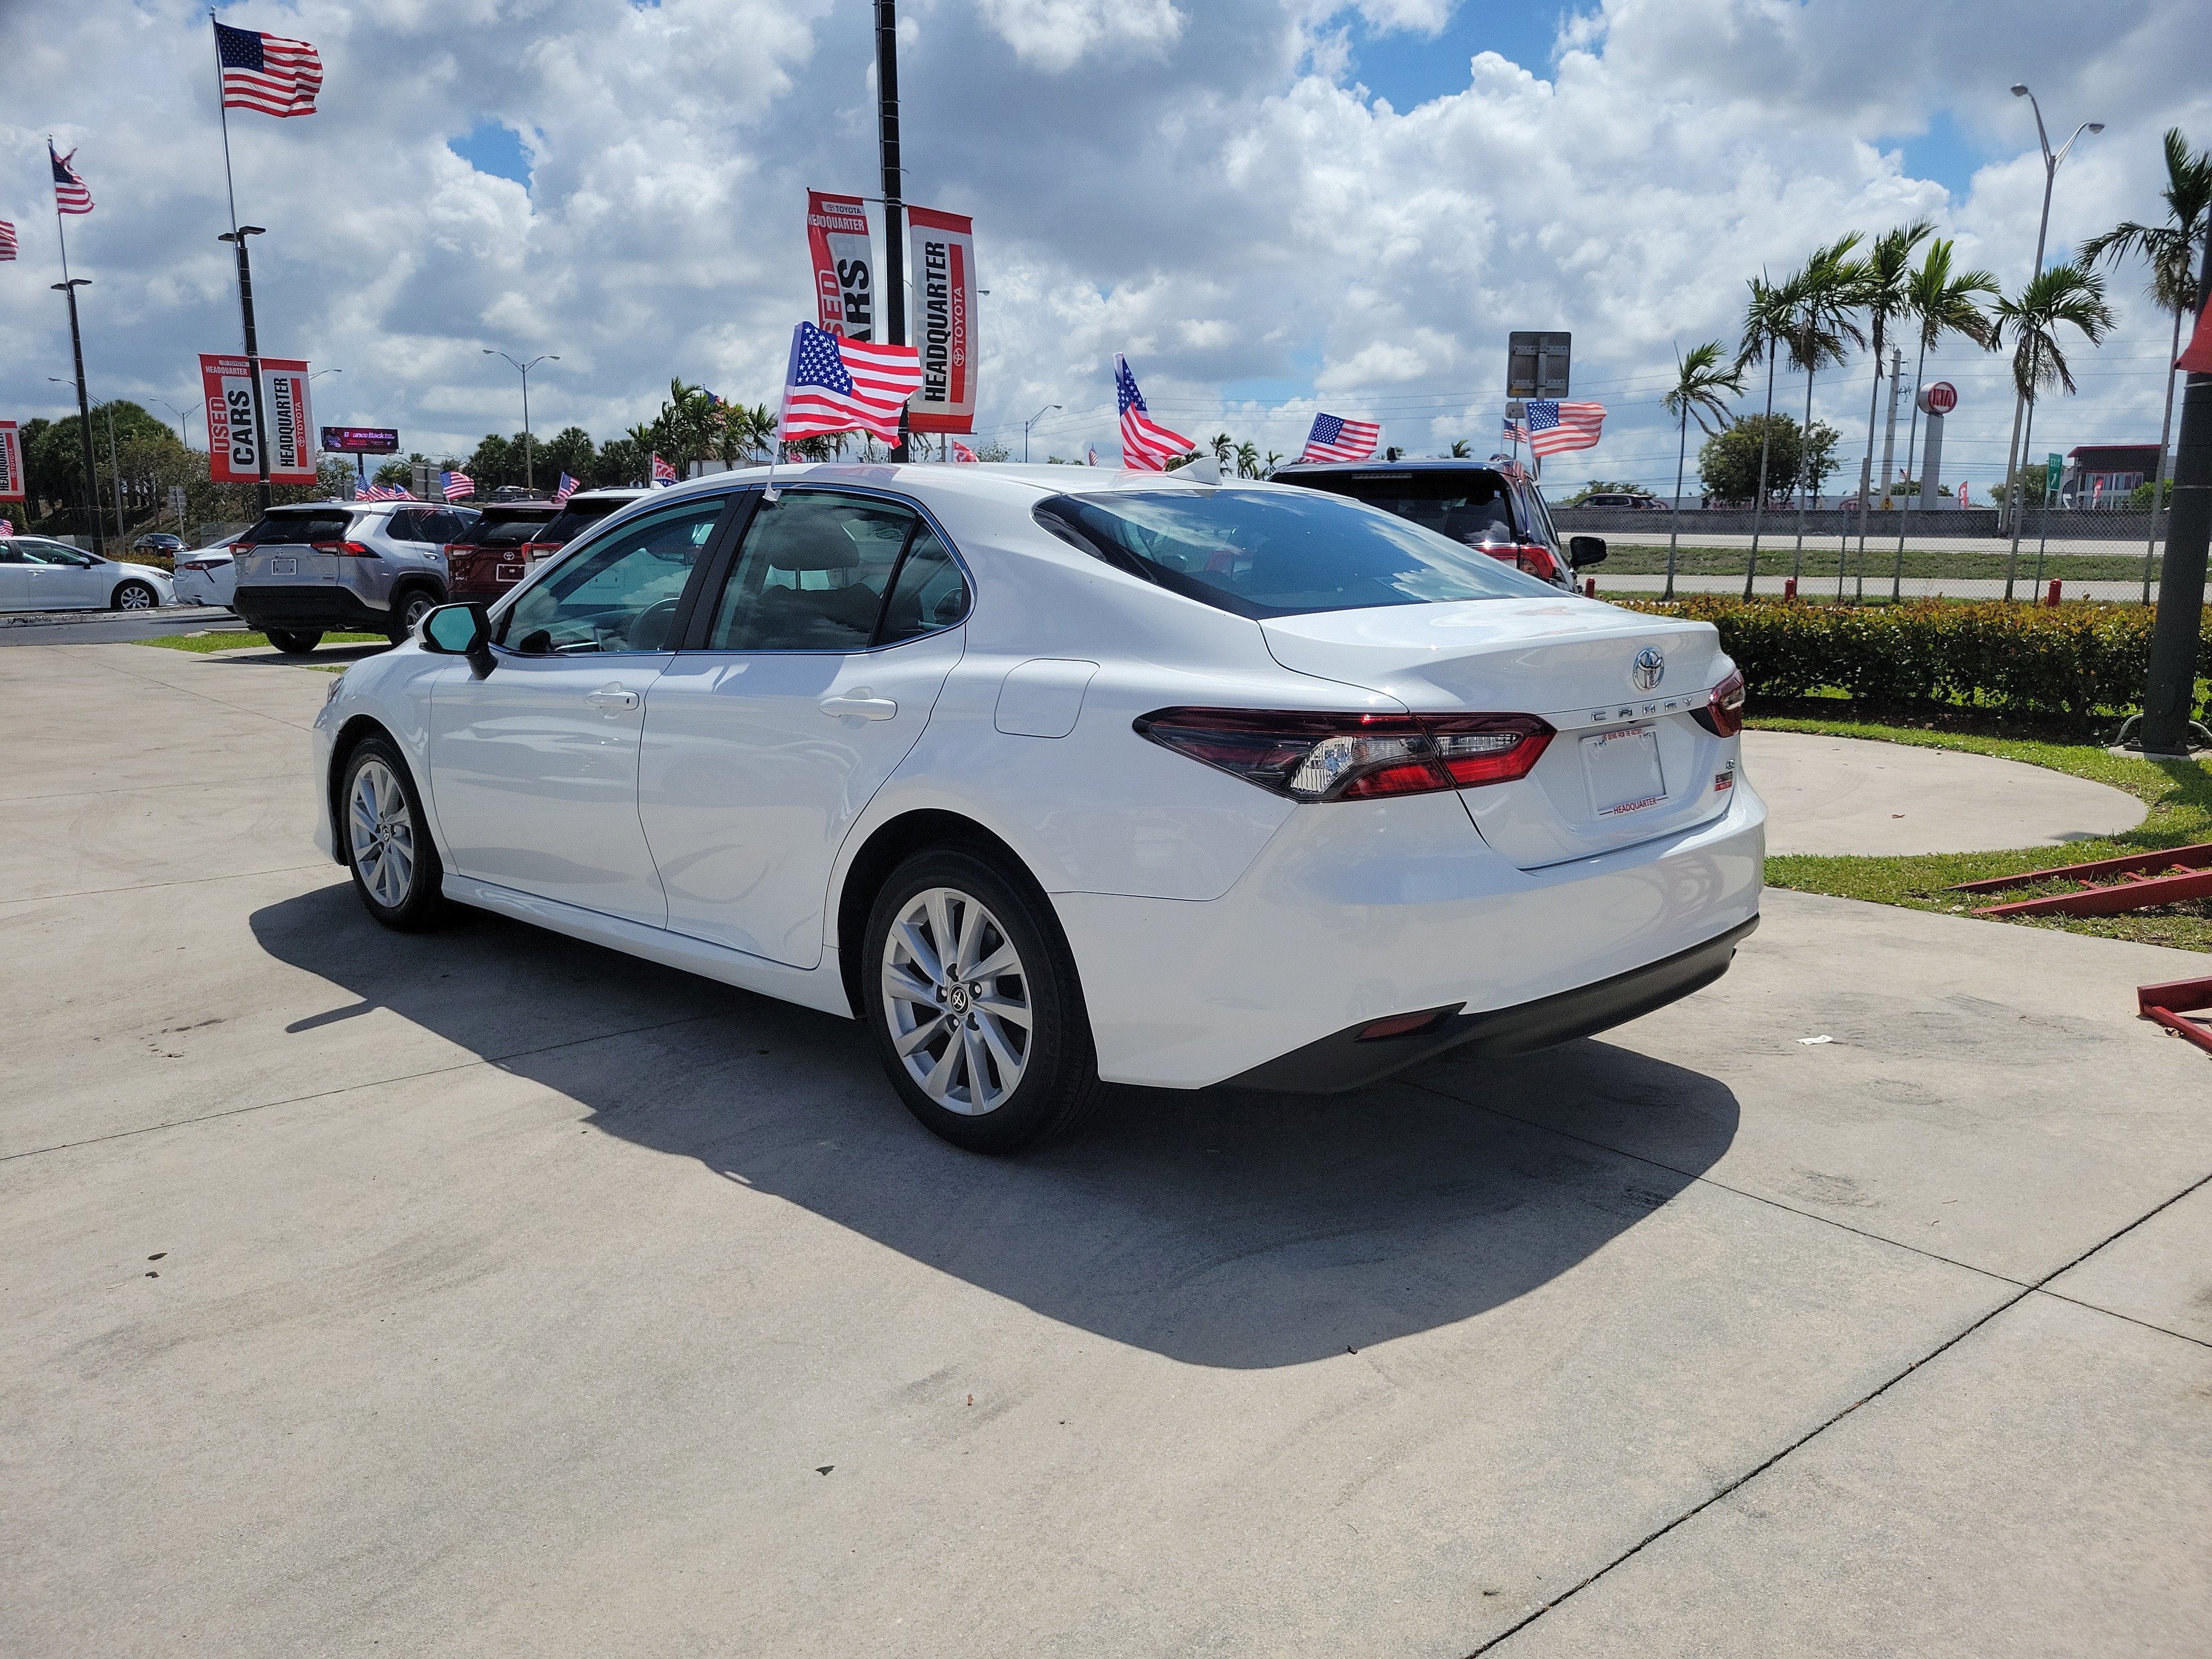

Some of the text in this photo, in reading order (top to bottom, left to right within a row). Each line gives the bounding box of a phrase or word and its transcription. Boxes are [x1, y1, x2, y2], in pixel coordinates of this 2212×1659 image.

[808, 213, 865, 232] HEADQUARTER
[836, 205, 861, 215] TOYOTA
[821, 271, 845, 337] SED
[837, 258, 871, 343] RS
[954, 286, 963, 346] TOYOTA
[925, 241, 951, 402] HEADQUARTER
[206, 366, 247, 375] HEADQUARTER
[1933, 388, 1953, 408] KIA
[210, 397, 231, 453] USED
[228, 390, 255, 465] CARS
[273, 377, 295, 467] HEADQUARTER
[295, 402, 306, 435] TOYOTA
[2050, 458, 2061, 467] EXIT
[1592, 697, 1692, 721] CAMRY
[1613, 798, 1657, 815] HEADQUARTER
